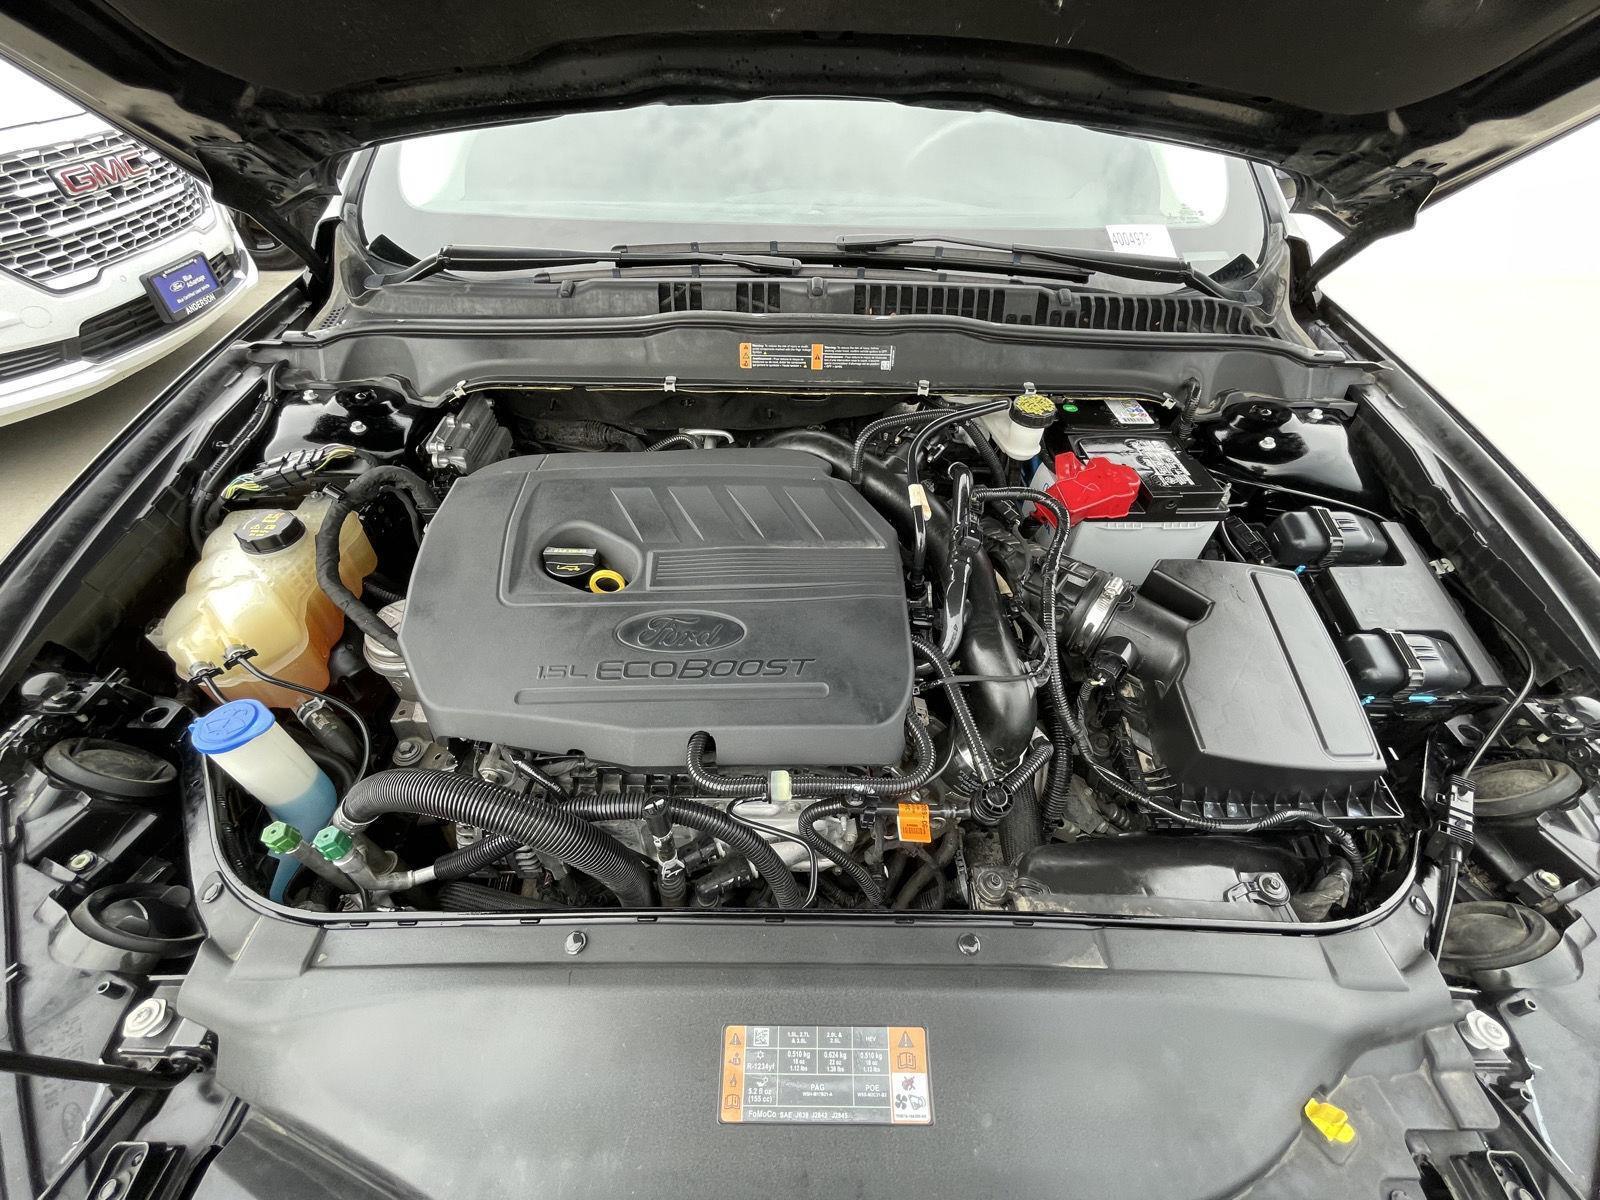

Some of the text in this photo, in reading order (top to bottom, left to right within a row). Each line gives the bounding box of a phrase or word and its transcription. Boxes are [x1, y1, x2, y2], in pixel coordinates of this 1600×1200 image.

[58, 151, 150, 195] GMC
[185, 293, 216, 315] ANDERSON
[637, 615, 724, 648] Ford
[536, 664, 589, 681] 1.5L
[787, 1050, 811, 1059] 0.510 kg
[839, 1051, 847, 1060] kg
[875, 1051, 883, 1060] kg
[746, 1062, 775, 1072] R-1234yf
[810, 1083, 825, 1091] PAG
[865, 1084, 880, 1092] POE
[748, 1095, 773, 1103] (155 cc)
[748, 1110, 777, 1118] FoMoCo
[780, 1111, 793, 1119] SAE
